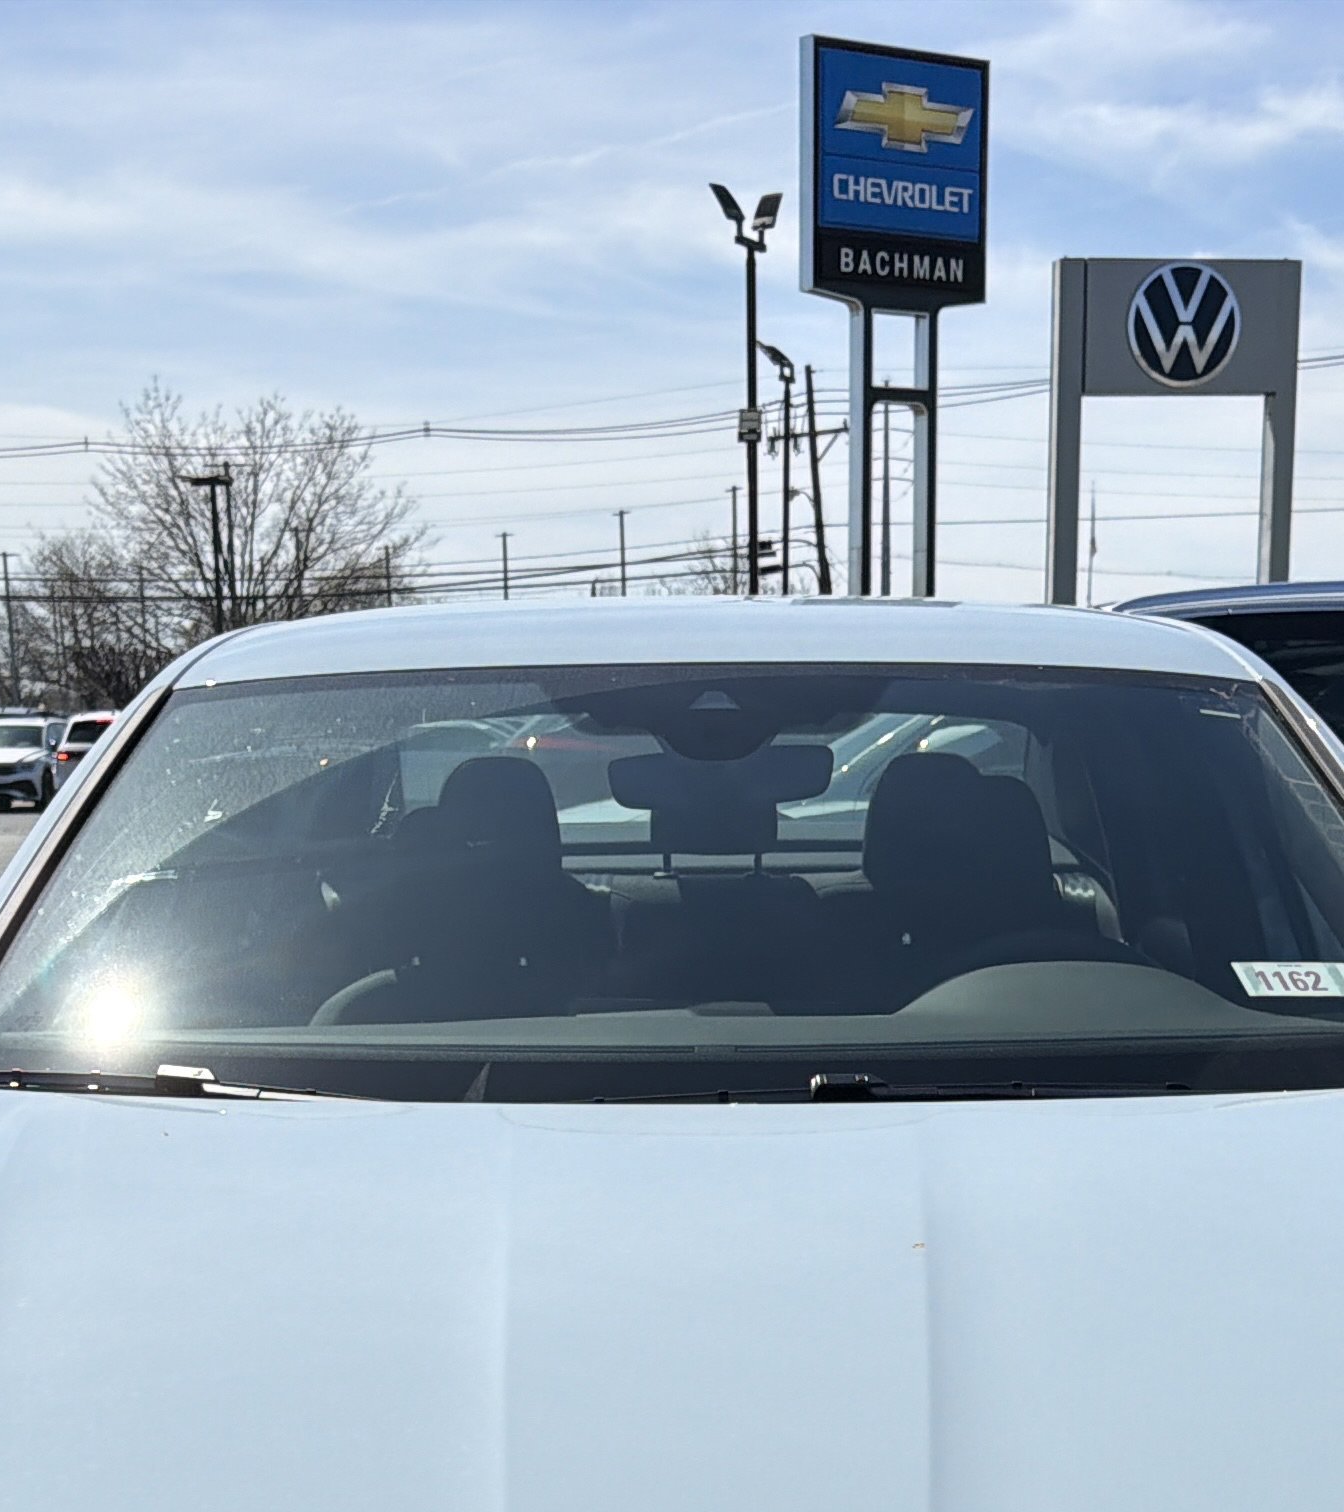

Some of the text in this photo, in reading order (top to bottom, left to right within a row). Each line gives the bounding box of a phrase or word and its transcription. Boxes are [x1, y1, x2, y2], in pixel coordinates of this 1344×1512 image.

[832, 172, 974, 214] CHEVROLET
[839, 247, 964, 283] BACHMAN
[1255, 970, 1329, 992] 1162
